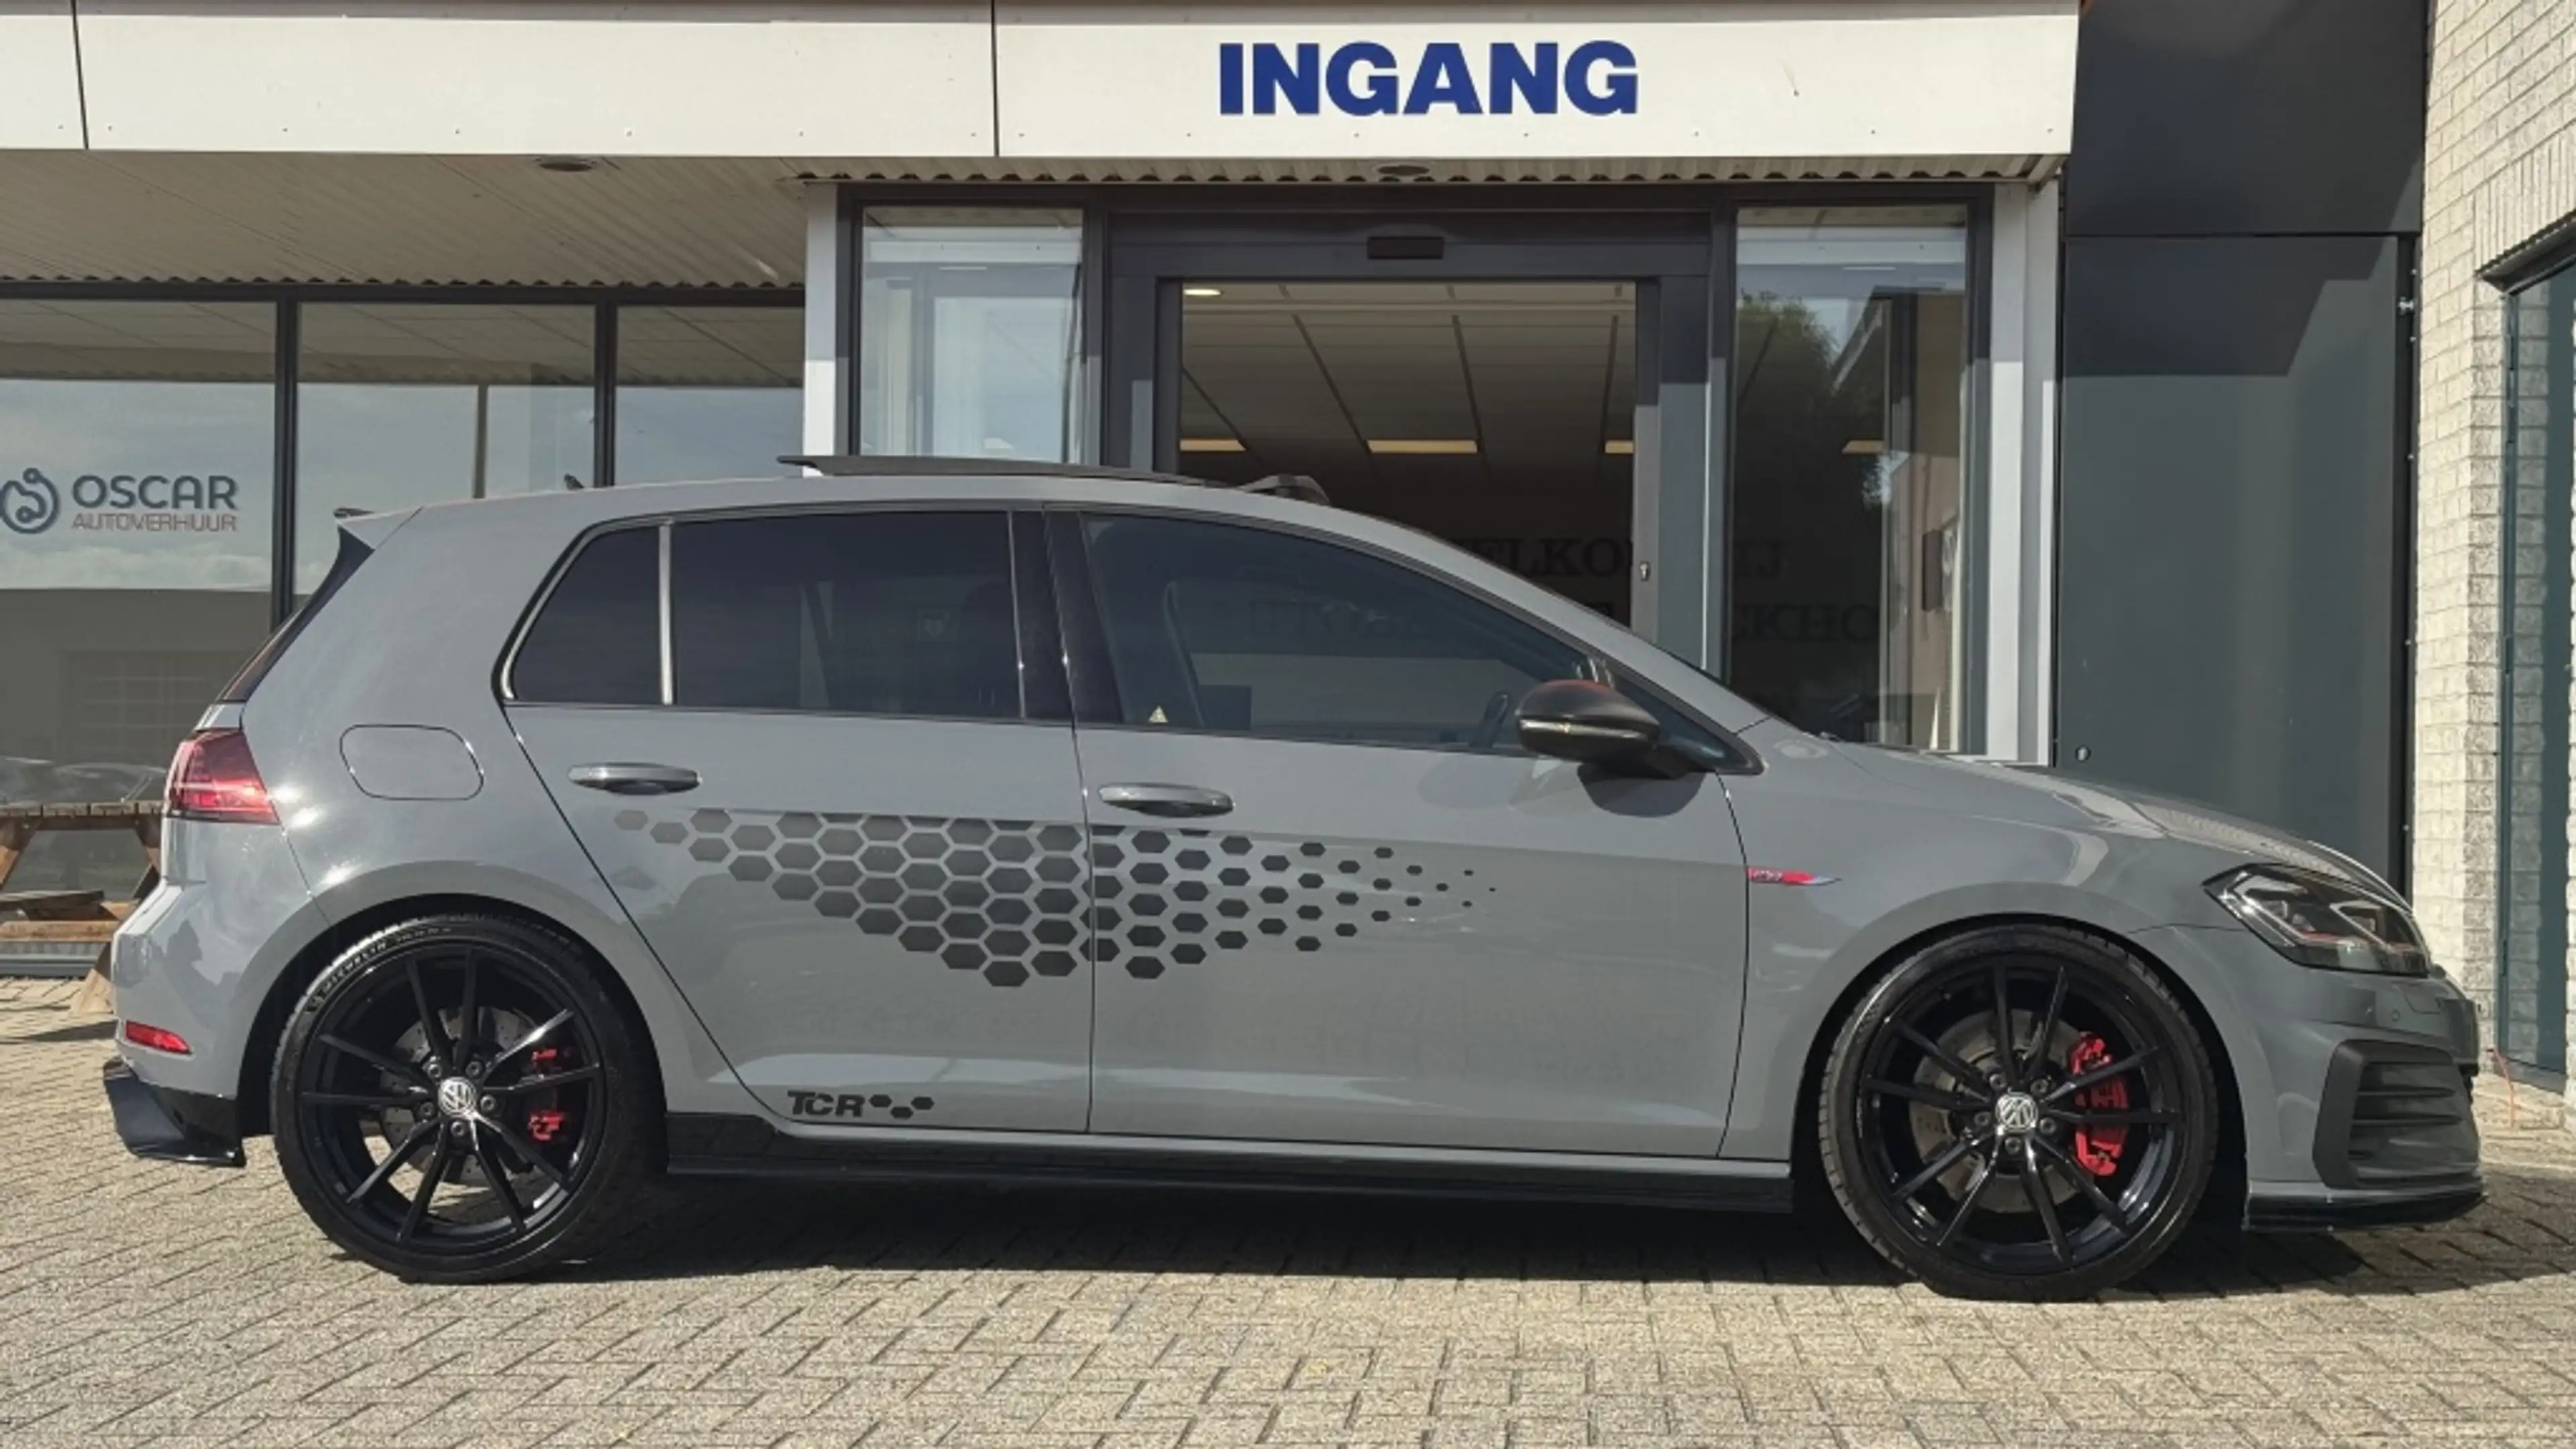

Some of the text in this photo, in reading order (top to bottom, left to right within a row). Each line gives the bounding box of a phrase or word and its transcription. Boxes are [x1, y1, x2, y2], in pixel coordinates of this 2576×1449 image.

[1220, 40, 1638, 116] INGANG
[72, 474, 239, 510] OSCAR
[72, 513, 238, 532] AUTOVERHUUR
[787, 1089, 865, 1118] TCR
